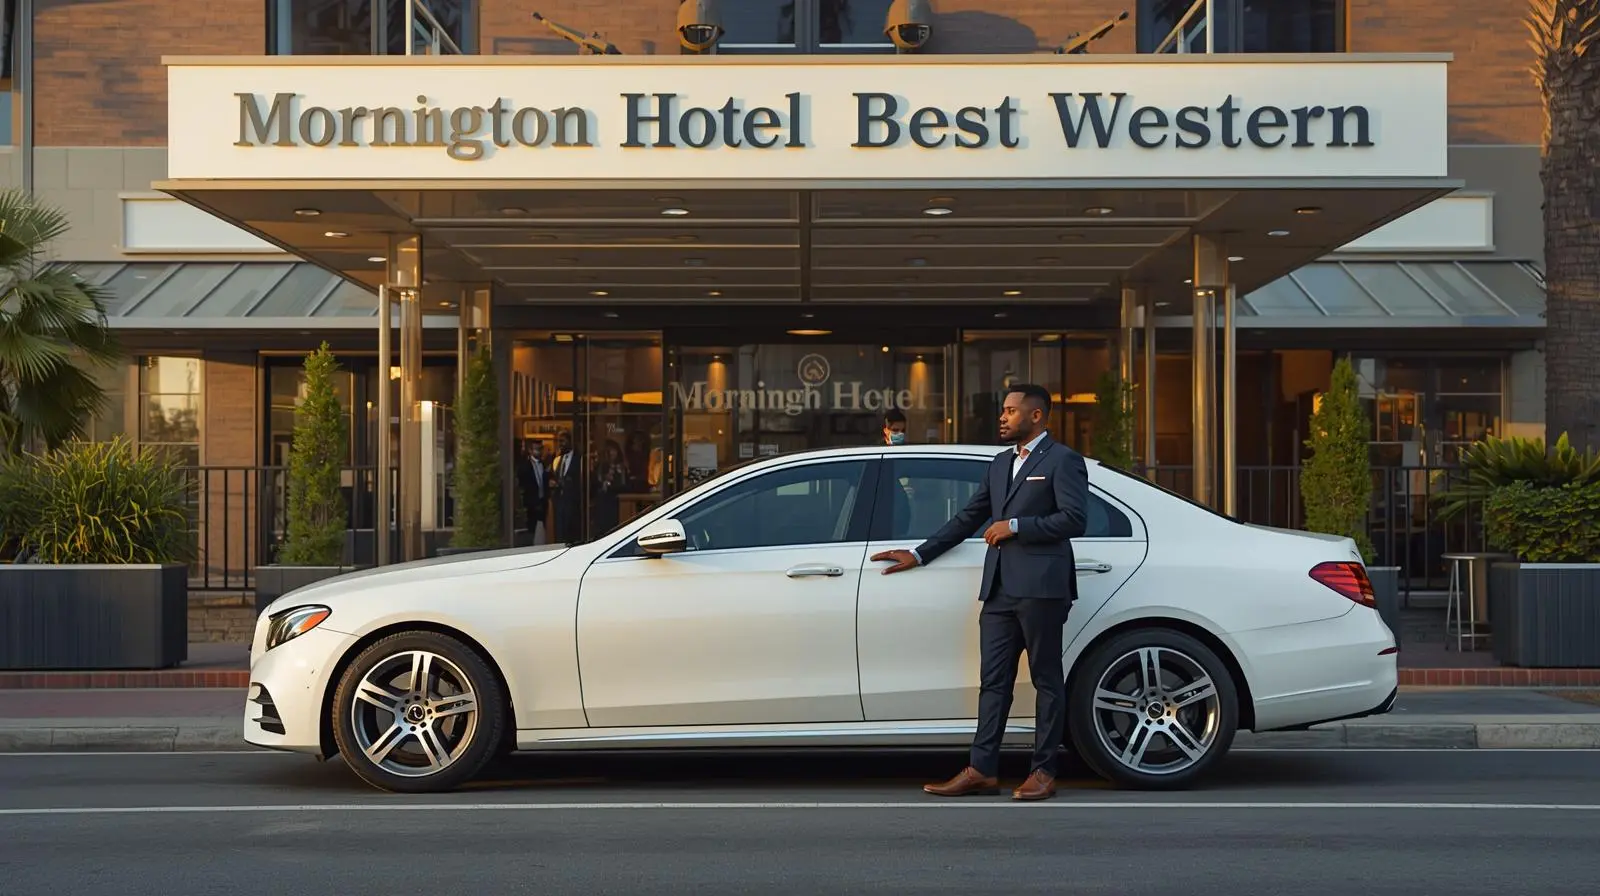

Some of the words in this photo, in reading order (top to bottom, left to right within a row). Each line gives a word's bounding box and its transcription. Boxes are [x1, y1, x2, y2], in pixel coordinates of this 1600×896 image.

[619, 92, 806, 148] Hotel
[850, 92, 1020, 148] Best
[1048, 91, 1375, 149] Western
